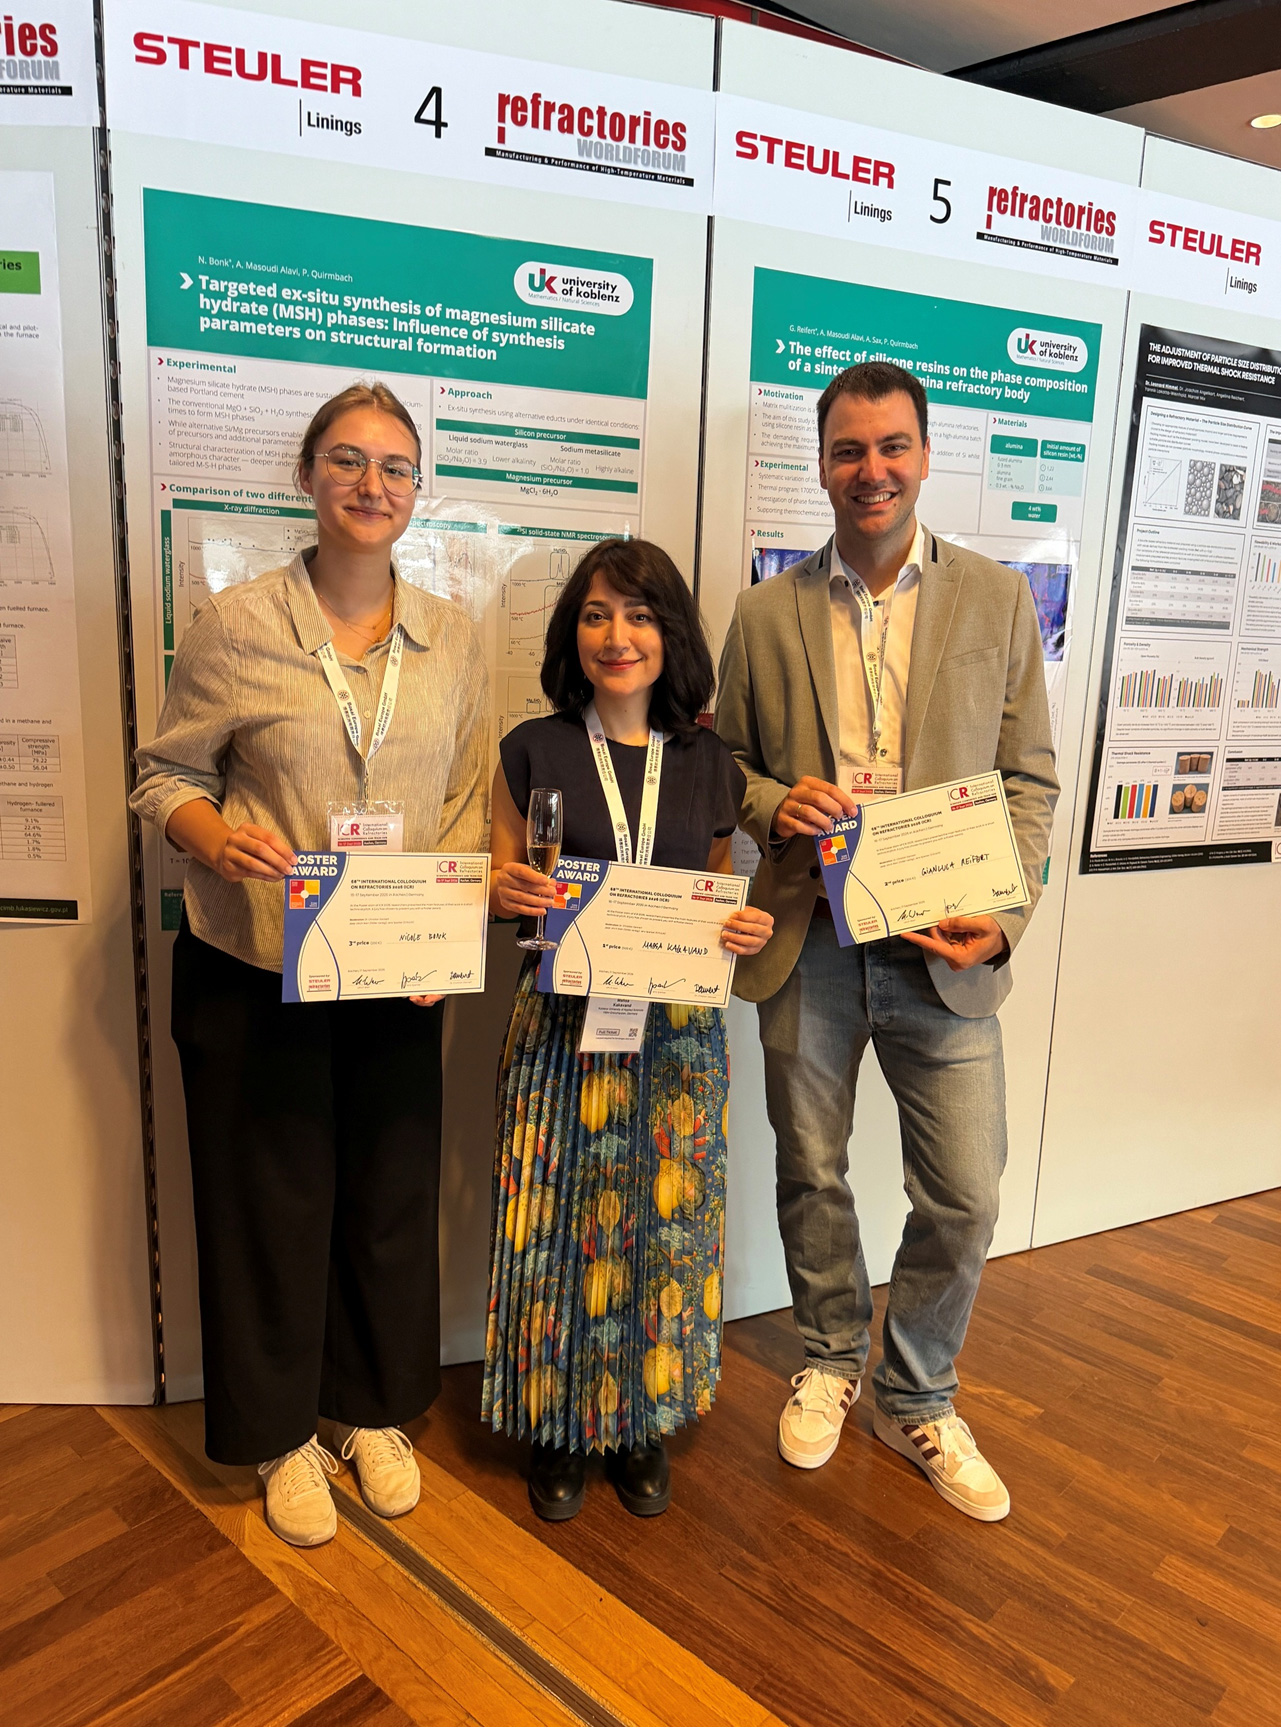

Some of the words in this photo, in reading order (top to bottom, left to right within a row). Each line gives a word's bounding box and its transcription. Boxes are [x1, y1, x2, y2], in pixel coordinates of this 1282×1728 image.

[0, 15, 59, 58] ies
[133, 32, 362, 98] STEULER
[28, 86, 62, 94] Materials
[414, 86, 448, 139] 4
[307, 111, 362, 137] Linings
[497, 92, 687, 152] refractories
[577, 138, 686, 172] WORLDFORUM
[735, 130, 896, 189] STEULER
[495, 149, 542, 164] Manufacturing
[551, 158, 590, 171] Performance
[592, 164, 599, 172] of
[600, 166, 655, 180] High-Temperature
[657, 174, 685, 185] Materials
[929, 178, 952, 224] 5
[854, 200, 893, 223] Linings
[985, 185, 1117, 237] refractories
[1040, 224, 1115, 254] WORLDFORUM
[1148, 219, 1262, 266] STEULER
[983, 235, 1016, 247] Manufacturing
[1021, 242, 1049, 253] Performance
[1055, 247, 1093, 260] High-Temperature
[1093, 255, 1113, 264] Materials
[198, 256, 207, 265] N.
[235, 260, 244, 269] A.
[245, 261, 279, 274] Masoudi
[280, 266, 301, 277] Alavi,
[302, 268, 310, 277] P.
[311, 269, 353, 283] Quirmbach
[562, 276, 618, 294] university
[1229, 276, 1258, 294] Linings
[561, 287, 573, 297] of
[576, 287, 620, 303] koblenz
[198, 275, 277, 298] Targeted
[281, 287, 339, 306] ex-situ
[343, 293, 421, 315] synthesis
[425, 303, 442, 317] of
[445, 305, 537, 329] magnesium
[541, 316, 596, 336] silicate
[199, 294, 268, 316] hydrate
[272, 303, 322, 325] (MSH)
[327, 309, 389, 330] phases:
[393, 316, 468, 339] Influence
[472, 327, 488, 341] of
[491, 330, 565, 350] synthesis
[200, 316, 301, 339] parameters
[305, 327, 326, 341] on
[330, 330, 413, 351] structural
[416, 337, 497, 360] formation
[789, 325, 797, 333] G.
[819, 329, 826, 337] A.
[826, 330, 850, 340] Masoudi
[850, 333, 865, 341] Alavi,
[872, 336, 883, 344] Sax,
[883, 337, 890, 345] P.
[890, 338, 919, 350] Quirmbach
[1039, 339, 1077, 354] university
[1039, 349, 1048, 357] of
[1049, 349, 1079, 362] koblenz
[1149, 342, 1161, 352] THE
[1161, 344, 1202, 359] ADJUSTMENT
[1202, 353, 1211, 361] OF
[1211, 355, 1238, 367] PARTICLE
[1238, 359, 1250, 369] SIZE
[166, 358, 237, 374] Experimental
[788, 341, 812, 356] The
[814, 344, 851, 362] effect
[853, 350, 867, 363] of
[916, 360, 950, 374] resins
[952, 364, 968, 377] on
[969, 366, 989, 380] the
[990, 368, 1022, 386] phase
[1024, 373, 1088, 394] composition
[1147, 354, 1161, 364] FOR
[1161, 356, 1193, 370] IMPROVED
[1193, 362, 1220, 375] THERMAL
[1220, 367, 1242, 379] SHOCK
[1242, 371, 1276, 385] RESISTANCE
[787, 359, 802, 372] of
[803, 362, 812, 373] a
[946, 379, 1002, 401] refractory
[1004, 386, 1030, 403] body
[167, 384, 189, 394] based
[189, 387, 218, 398] Portland
[219, 390, 245, 400] cement
[448, 387, 493, 400] Approach
[763, 389, 804, 401] Motivation
[997, 418, 1028, 428] Materials
[448, 435, 469, 445] Liquid
[469, 436, 494, 446] sodium
[494, 439, 528, 449] waterglass
[514, 428, 535, 438] Silicon
[536, 431, 567, 441] precursor
[560, 445, 584, 454] Sodium
[584, 447, 621, 457] metasilicate
[1005, 442, 1024, 450] alumina
[168, 459, 195, 467] tailored
[195, 461, 217, 469] M-S-H
[217, 463, 242, 472] phases
[760, 460, 809, 473] Experimental
[505, 472, 542, 483] Magnesium
[543, 477, 573, 486] precursor
[169, 483, 231, 497] Comparison
[233, 488, 244, 497] of
[245, 490, 265, 499] two
[267, 492, 312, 503] different
[224, 504, 242, 514] X-ray
[243, 505, 280, 515] diffraction
[756, 529, 784, 539] Results
[163, 536, 172, 575] waterglass
[165, 602, 173, 624] Liquid
[947, 786, 970, 801] ICR
[297, 854, 338, 865] OSTER
[436, 860, 458, 873] ICR
[557, 859, 600, 872] POSTER
[291, 866, 338, 876] AWARD
[556, 869, 600, 882] AWARD
[693, 878, 716, 892] ICR
